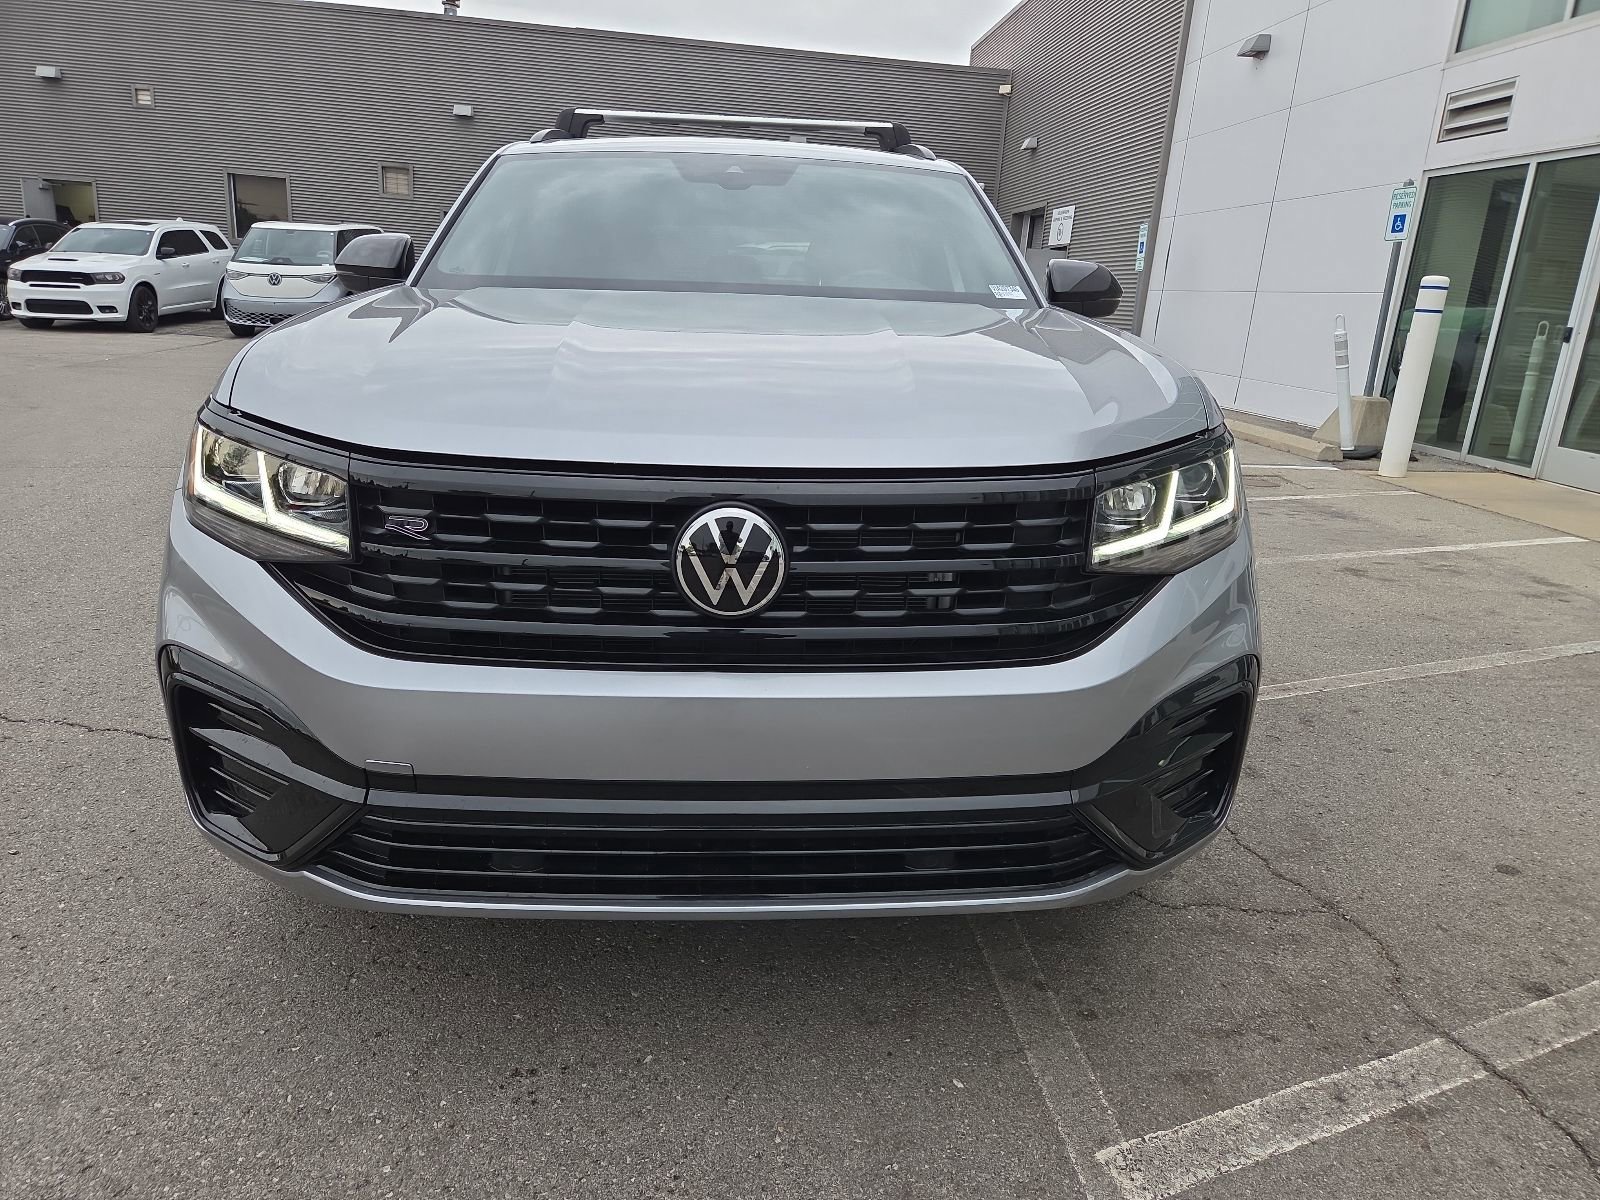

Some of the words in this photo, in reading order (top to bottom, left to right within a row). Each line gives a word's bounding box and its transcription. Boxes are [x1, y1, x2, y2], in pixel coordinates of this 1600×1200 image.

[1393, 192, 1415, 200] RESERVED
[1392, 201, 1412, 209] PARKING
[384, 514, 431, 541] R
[676, 506, 786, 616] VW
